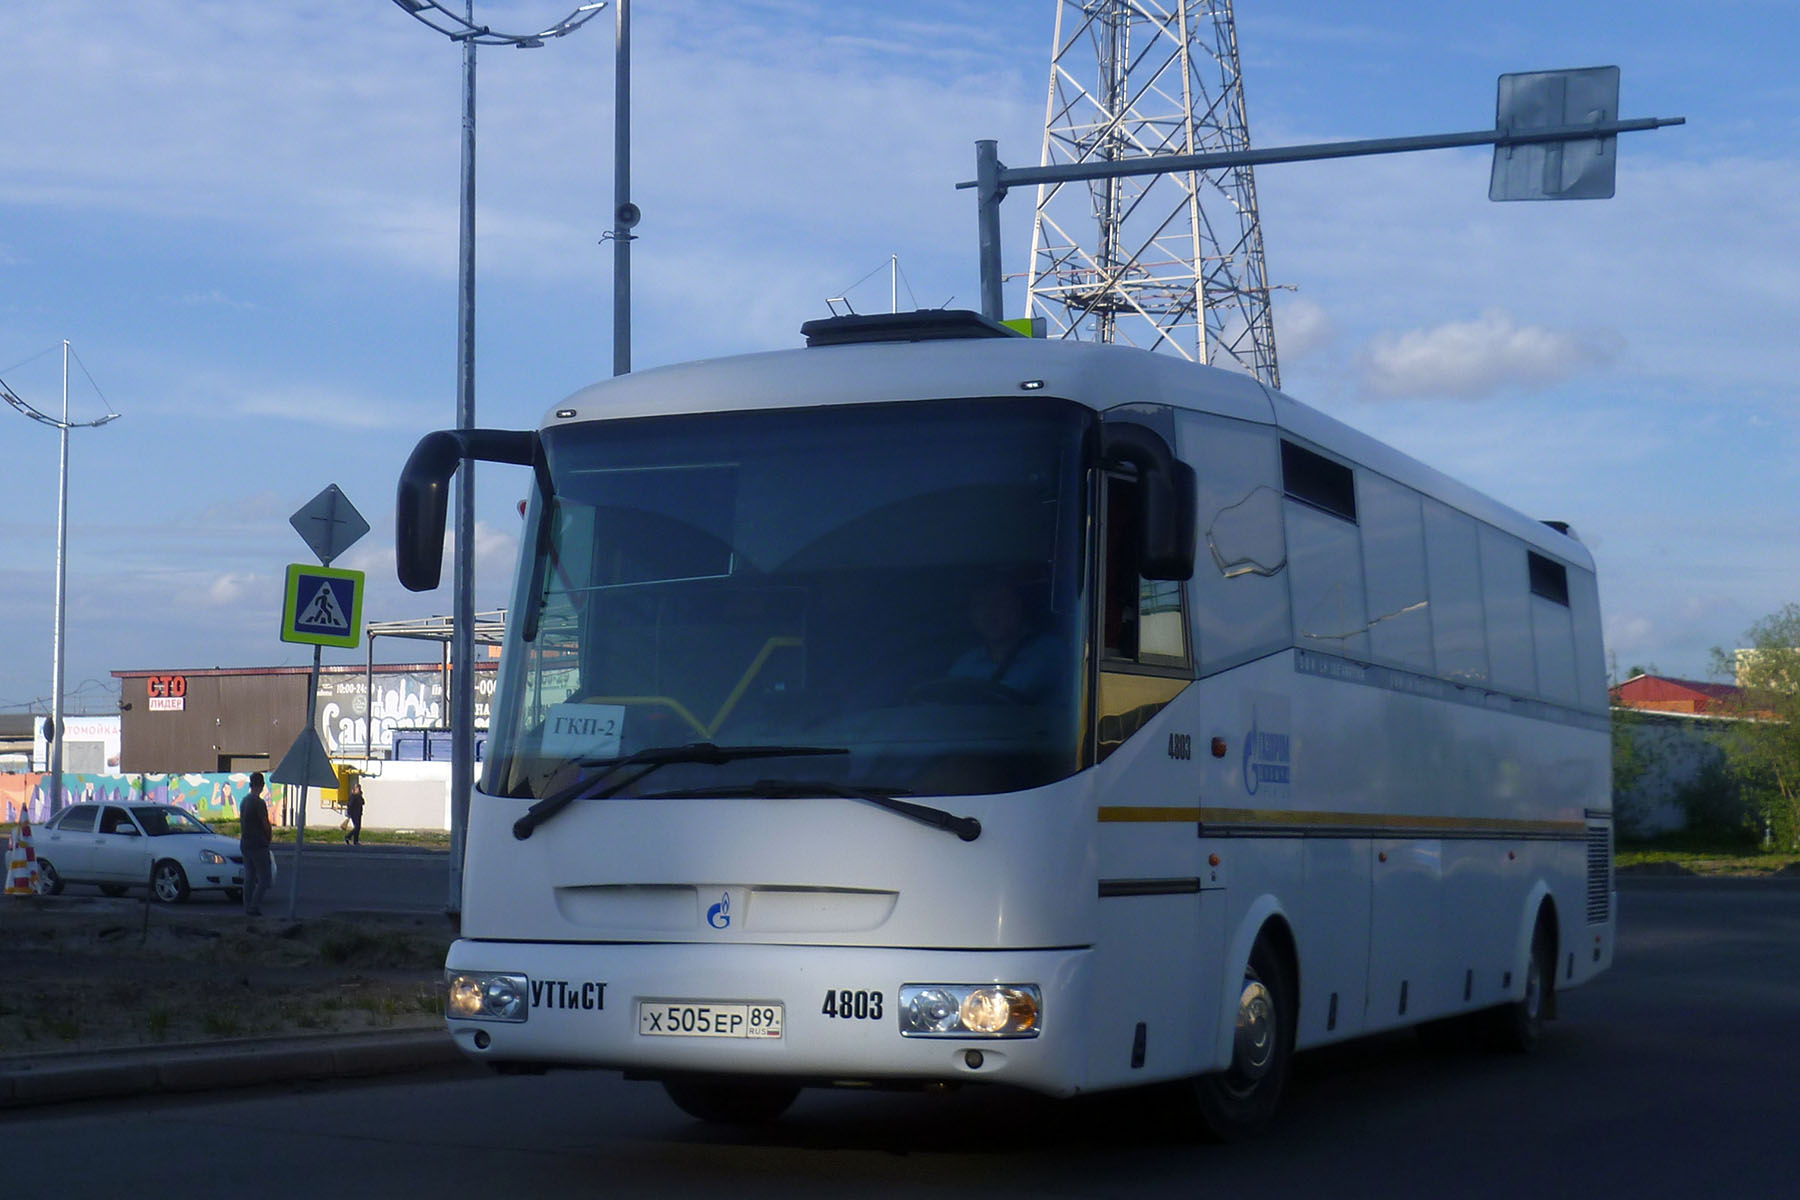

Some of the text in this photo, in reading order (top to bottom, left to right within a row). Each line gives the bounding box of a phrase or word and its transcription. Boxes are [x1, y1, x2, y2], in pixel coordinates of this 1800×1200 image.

[147, 675, 186, 698] СТО
[336, 683, 376, 695] 10:00-24:0
[150, 698, 182, 709] ЛИДЕР
[66, 723, 119, 736] ТОМОЙКА
[553, 717, 616, 737] ГКП-2
[1168, 733, 1191, 760] 4803
[531, 980, 608, 1010] УТТиСТ
[822, 989, 883, 1020] 4803
[750, 1008, 775, 1027] 89
[748, 1027, 767, 1035] RUS
